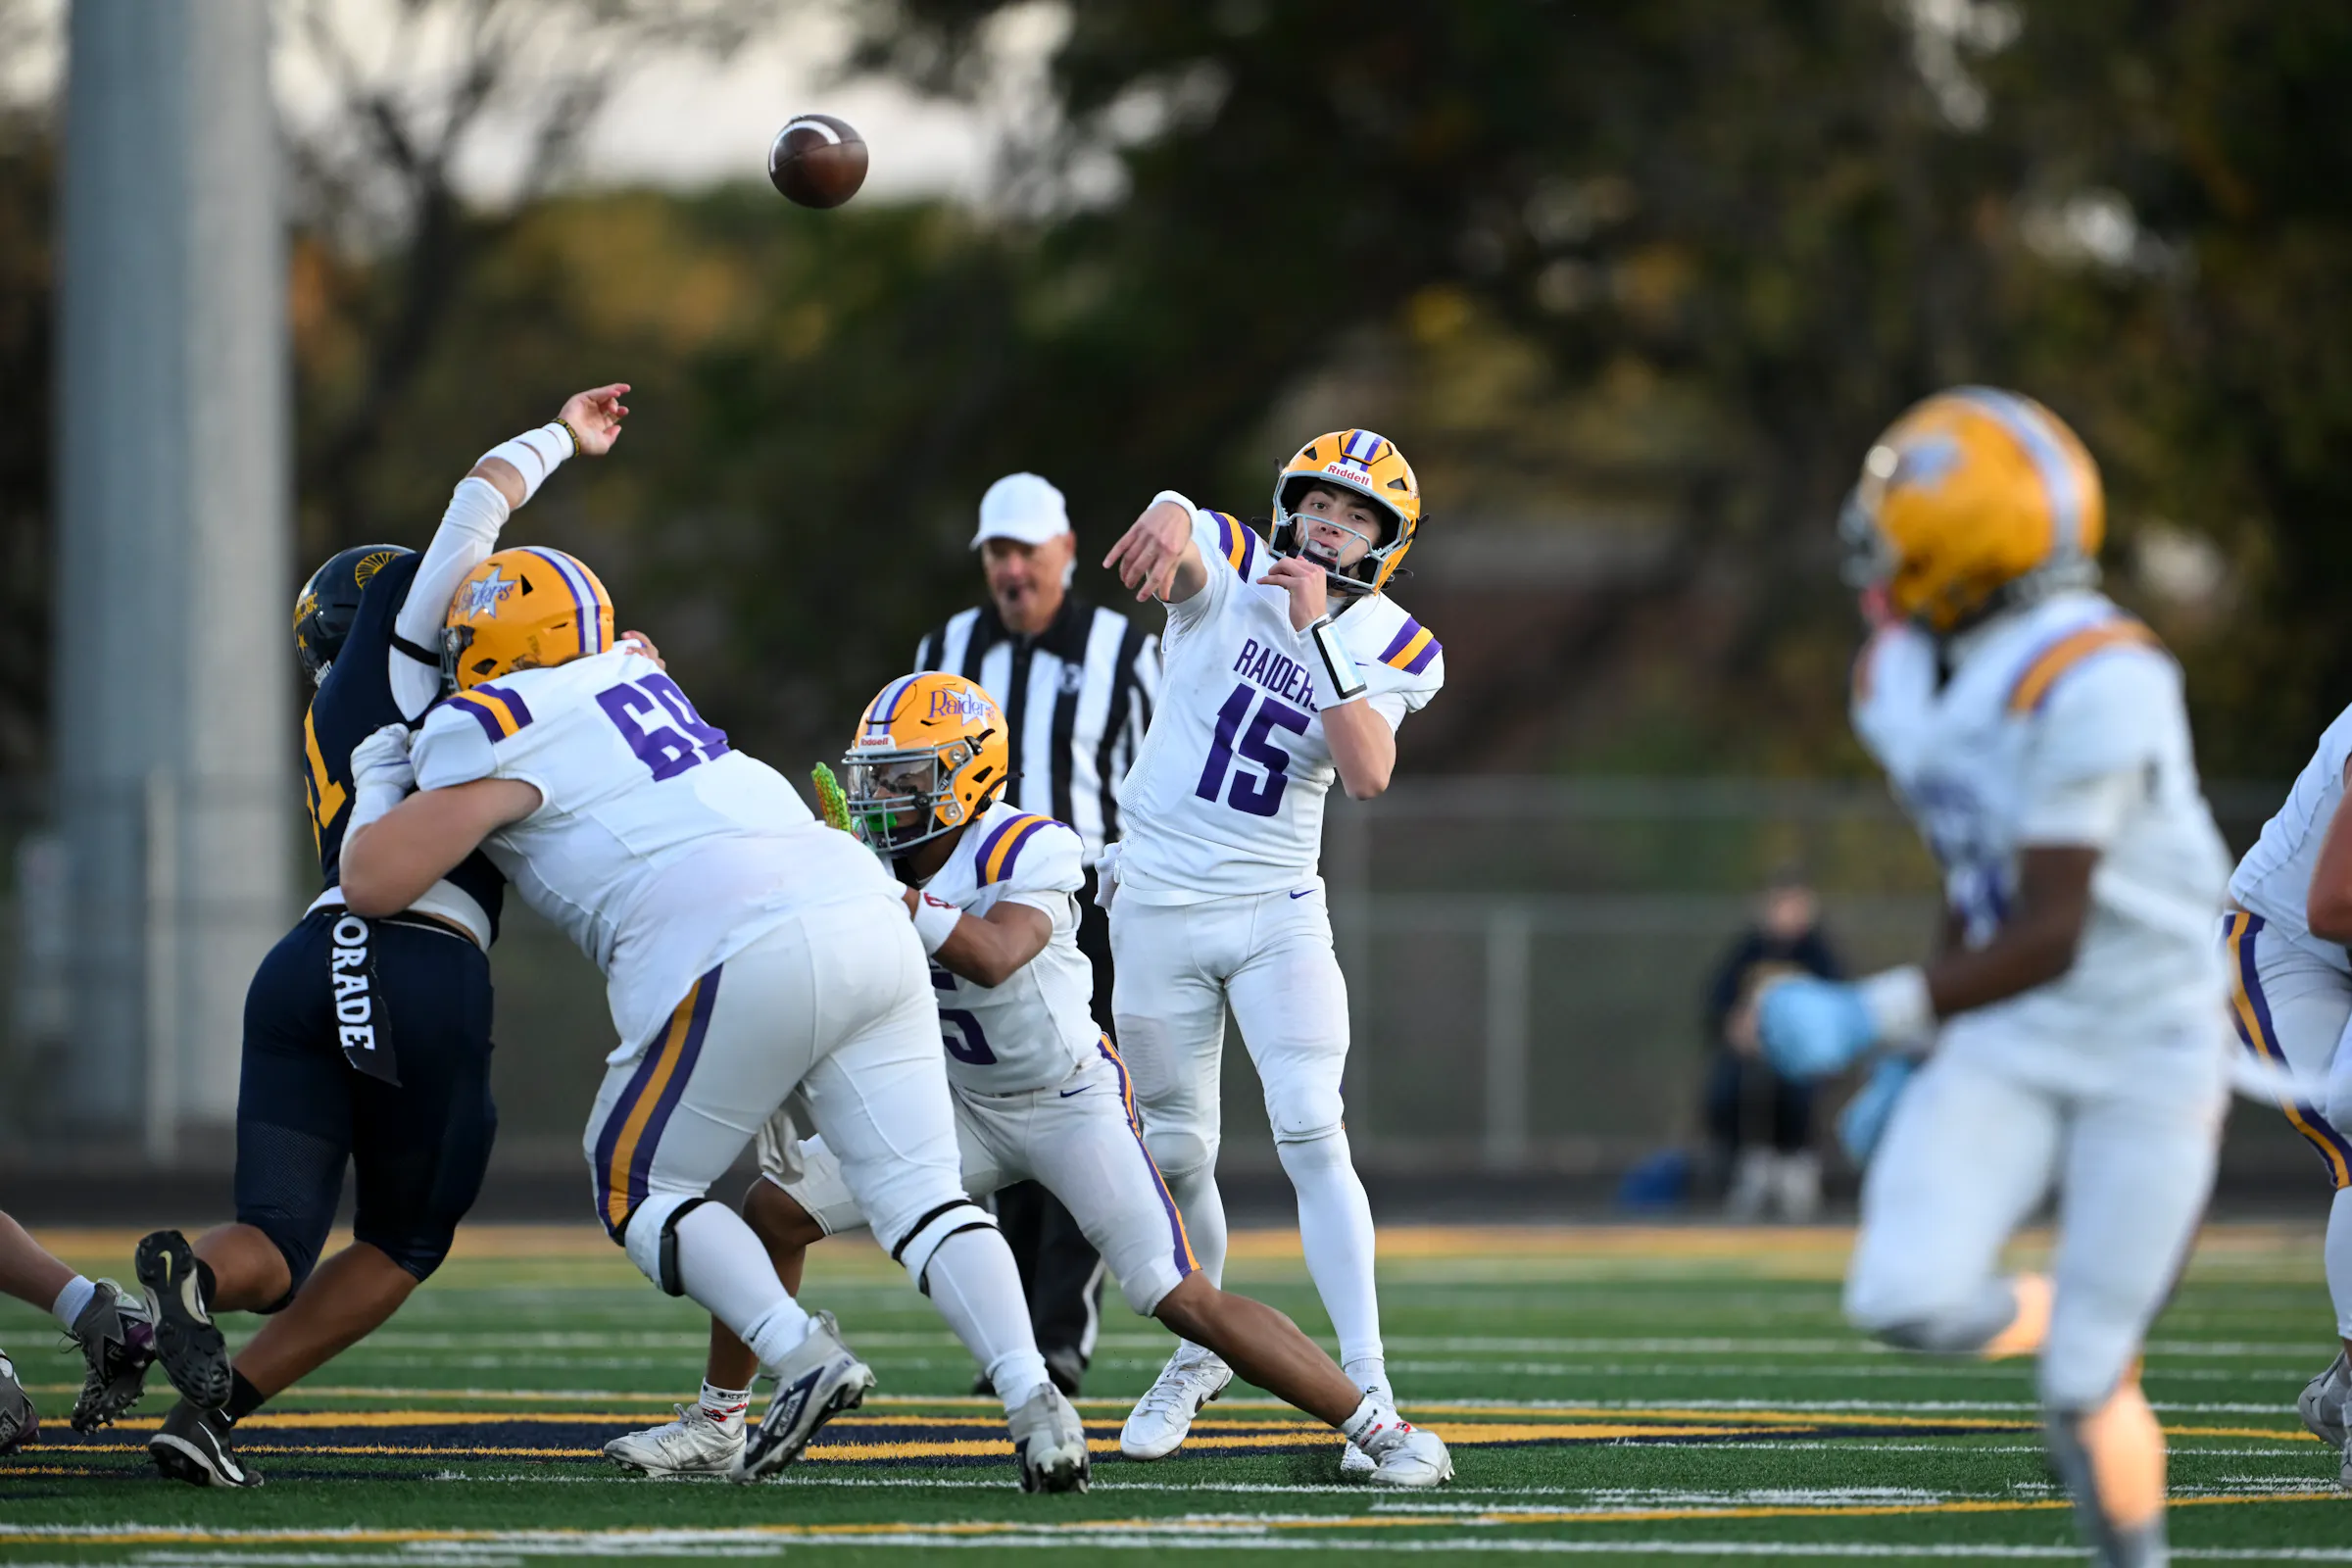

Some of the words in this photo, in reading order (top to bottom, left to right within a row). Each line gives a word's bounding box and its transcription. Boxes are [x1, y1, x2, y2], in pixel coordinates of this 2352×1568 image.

[1328, 465, 1370, 486] Riddell
[928, 689, 996, 720] Raiders
[1233, 638, 1318, 712] RAIDER
[1195, 682, 1311, 817] 15
[332, 913, 376, 1051] ORADE
